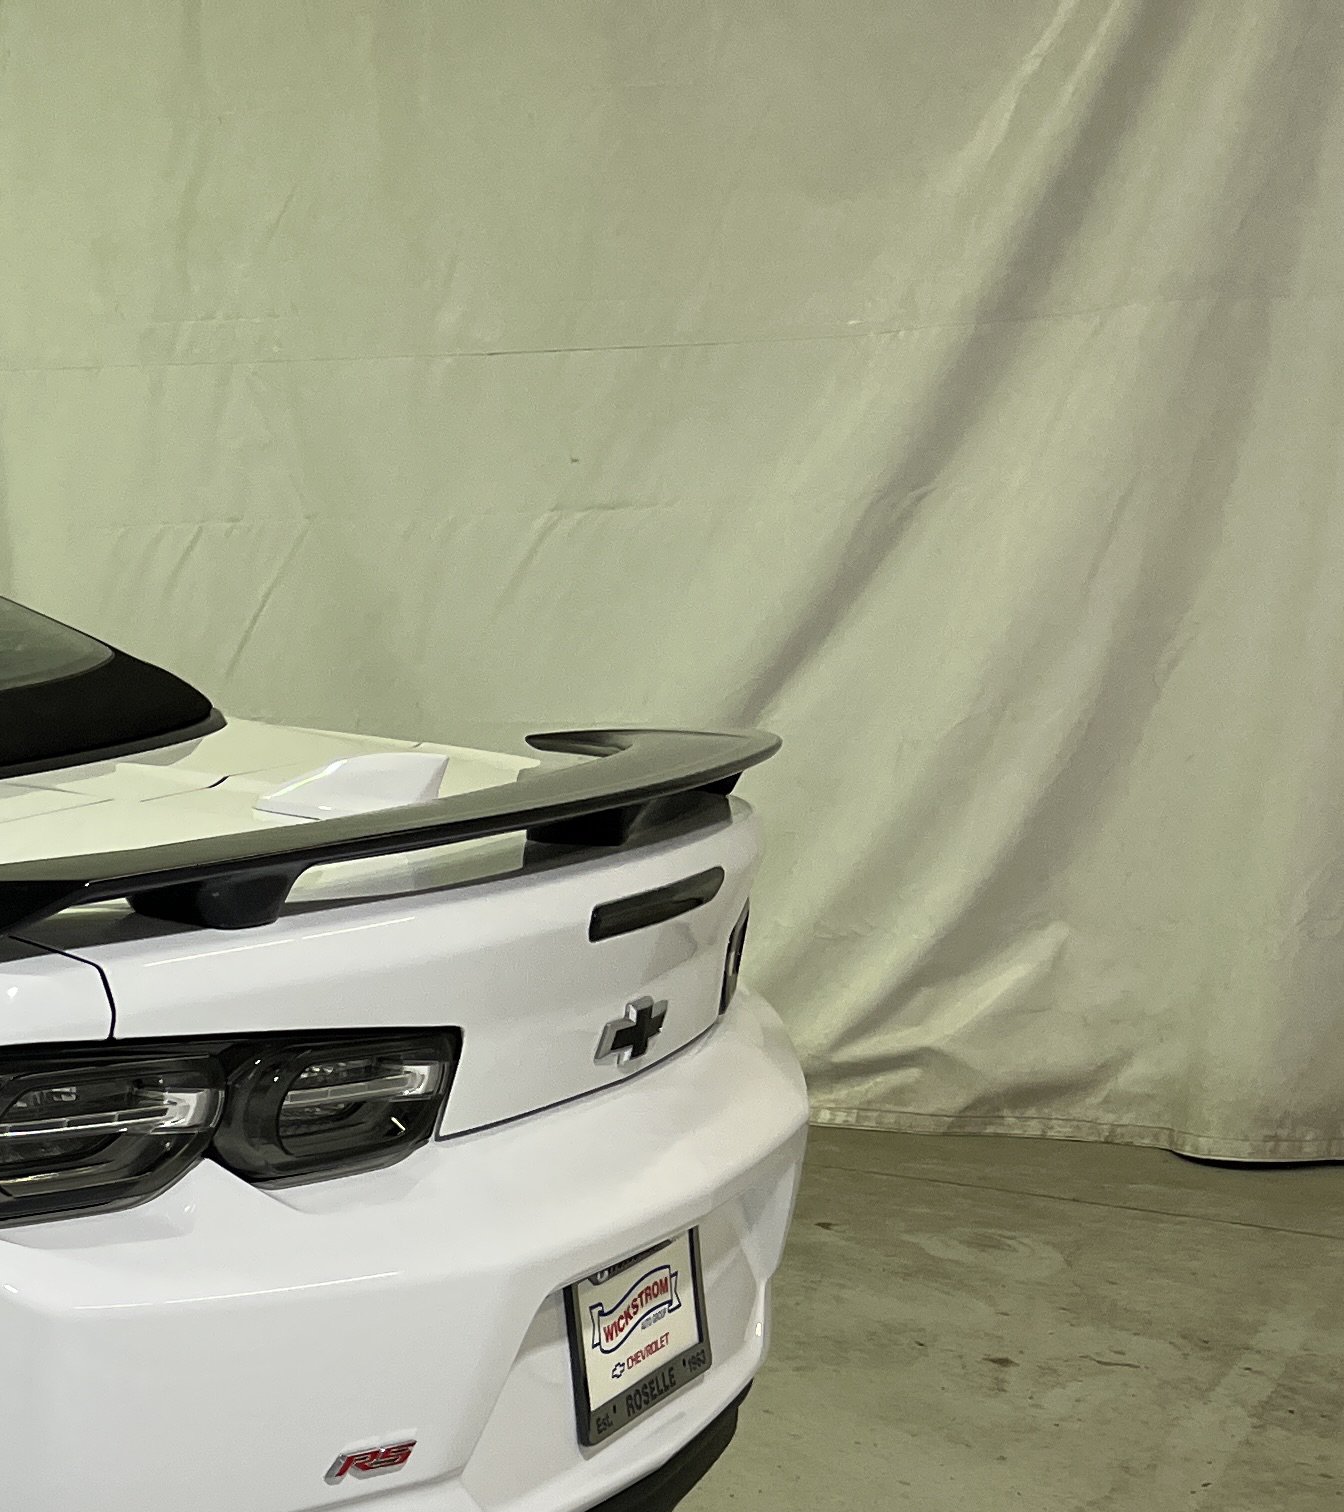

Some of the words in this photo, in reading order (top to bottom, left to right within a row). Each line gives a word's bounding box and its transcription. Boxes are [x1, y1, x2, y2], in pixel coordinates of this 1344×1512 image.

[603, 1276, 669, 1343] WICKSTROM
[626, 1332, 670, 1370] CHEVROLET
[625, 1367, 677, 1417] ROSELLE
[324, 1439, 417, 1486] RS
